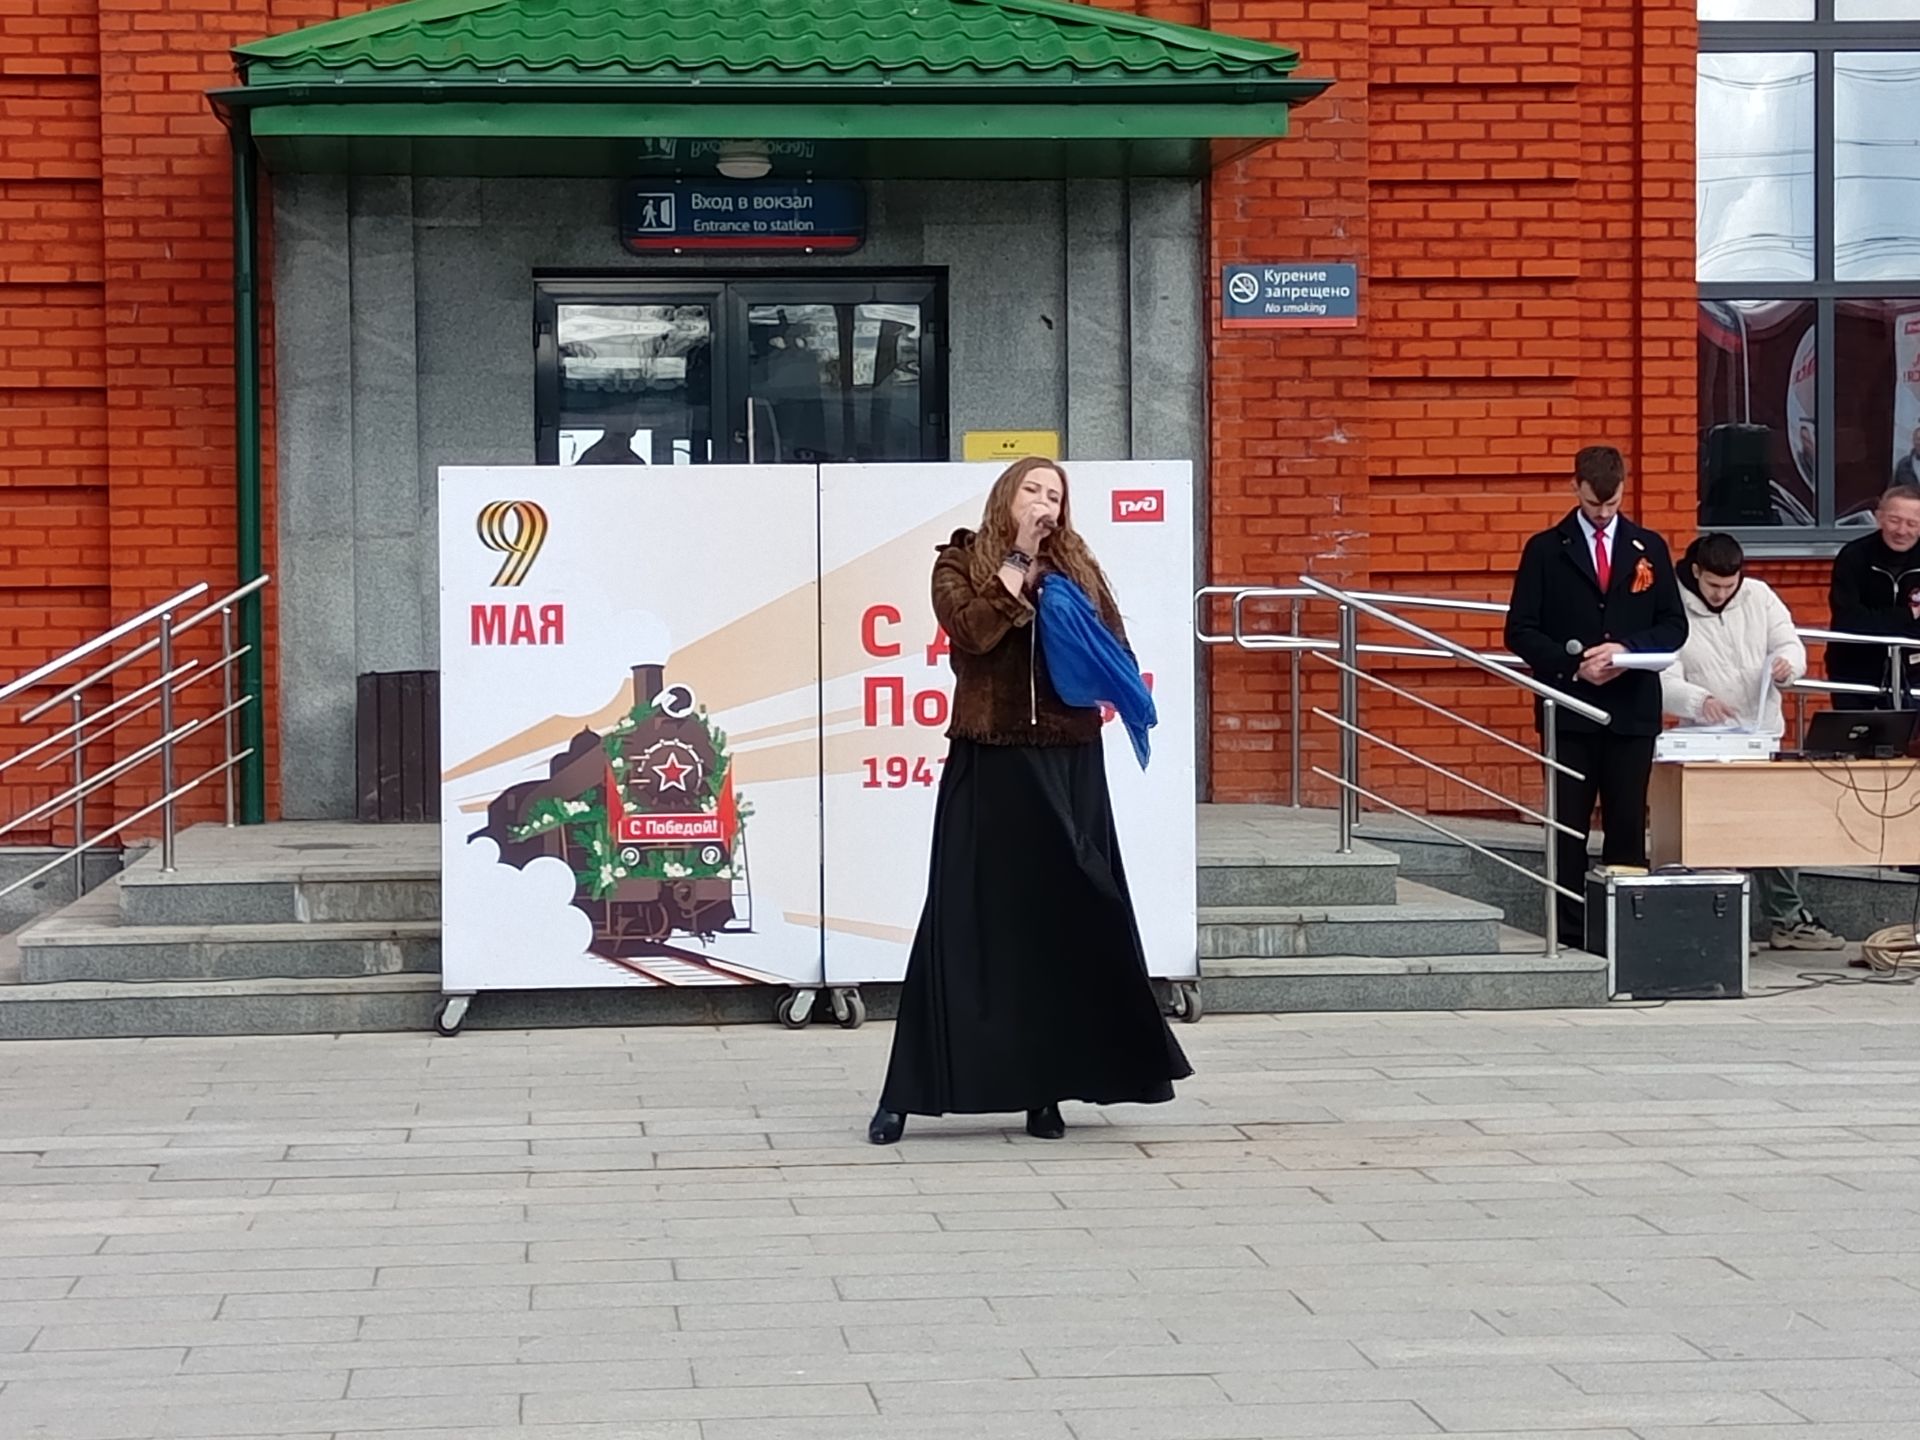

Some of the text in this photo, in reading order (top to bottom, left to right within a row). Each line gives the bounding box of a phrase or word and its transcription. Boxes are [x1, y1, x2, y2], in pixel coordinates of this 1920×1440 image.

[691, 193, 813, 212] Вход в вокзал
[693, 219, 814, 231] Entrance to station
[1264, 269, 1327, 285] Курение
[1264, 287, 1350, 300] запрещено
[1265, 302, 1326, 314] No smoking
[476, 500, 549, 588] 9
[470, 604, 565, 646] МАЯ
[861, 604, 902, 658] С
[630, 819, 718, 836] С Победой!
